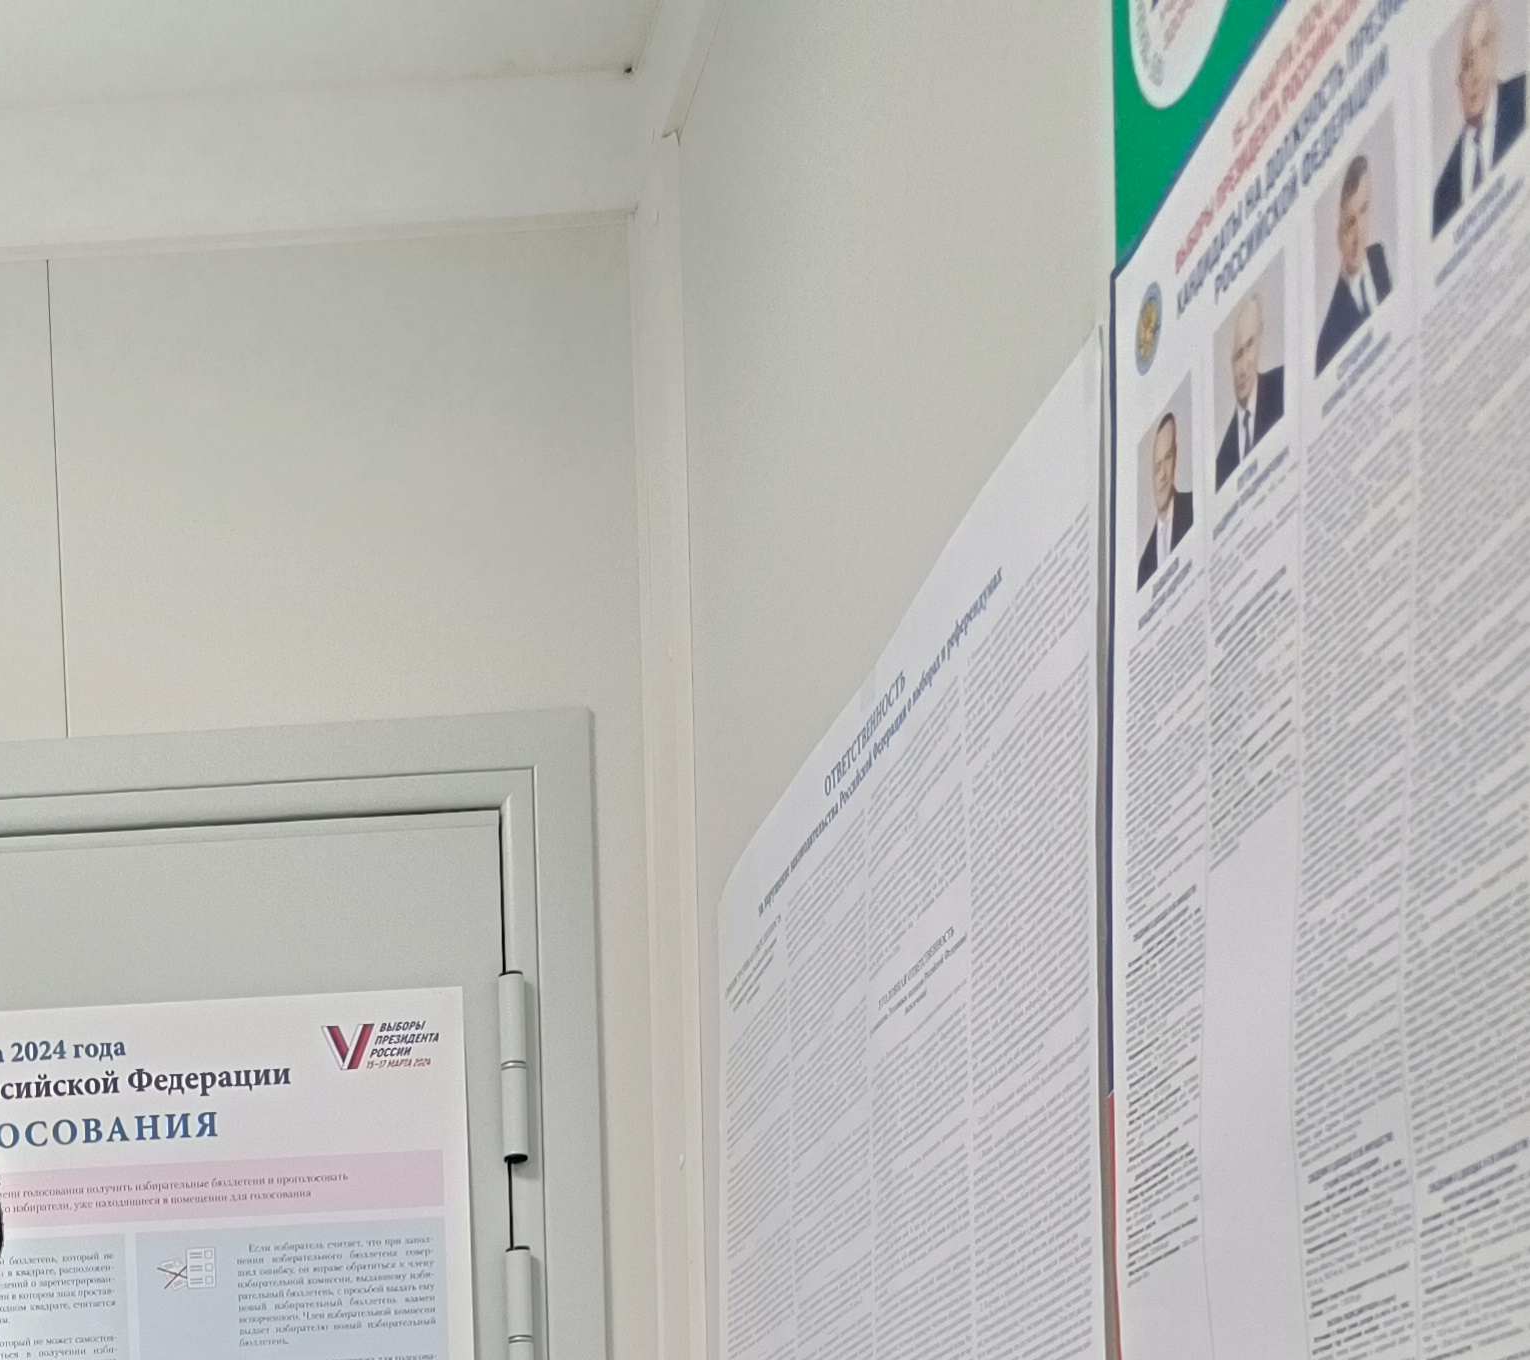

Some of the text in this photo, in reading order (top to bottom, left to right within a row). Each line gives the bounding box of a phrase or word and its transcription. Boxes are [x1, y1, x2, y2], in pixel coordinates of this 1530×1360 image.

[825, 670, 906, 796] ОТВЕТСТВЕННОСТЬ
[379, 1020, 426, 1033] ВЫБОРЫ
[374, 1032, 439, 1046] ПРЕЗИДЕНТА
[11, 1040, 66, 1062] 2024
[74, 1040, 126, 1062] года
[370, 1046, 412, 1058] РОССИИ
[127, 1068, 292, 1096] Федерации
[23, 1187, 84, 1199] голосования
[249, 1190, 311, 1200] голосования
